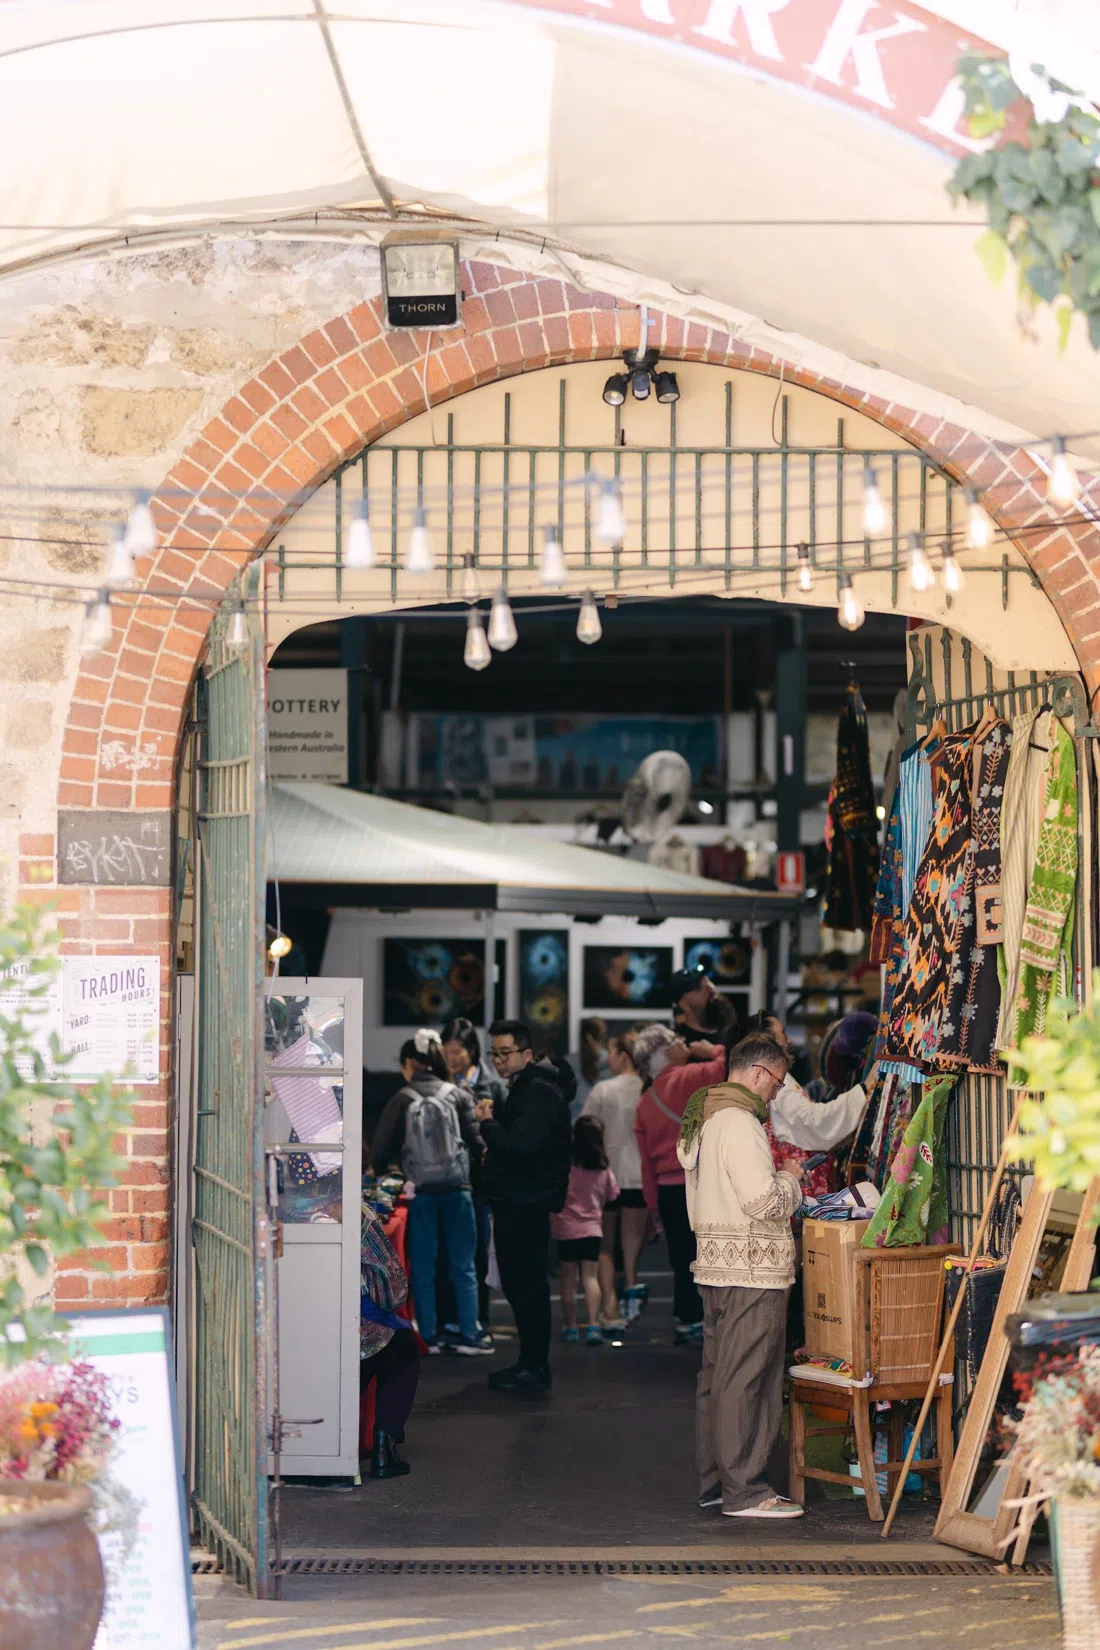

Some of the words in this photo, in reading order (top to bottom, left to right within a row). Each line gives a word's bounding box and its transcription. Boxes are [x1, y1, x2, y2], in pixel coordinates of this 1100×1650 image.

[398, 303, 446, 313] THORN
[267, 699, 341, 714] OTTERY
[268, 730, 322, 740] Handmade
[324, 730, 334, 739] in
[266, 744, 298, 753] estern
[300, 743, 345, 753] Australia
[80, 967, 145, 999] TRADING
[121, 987, 151, 1003] HOURS
